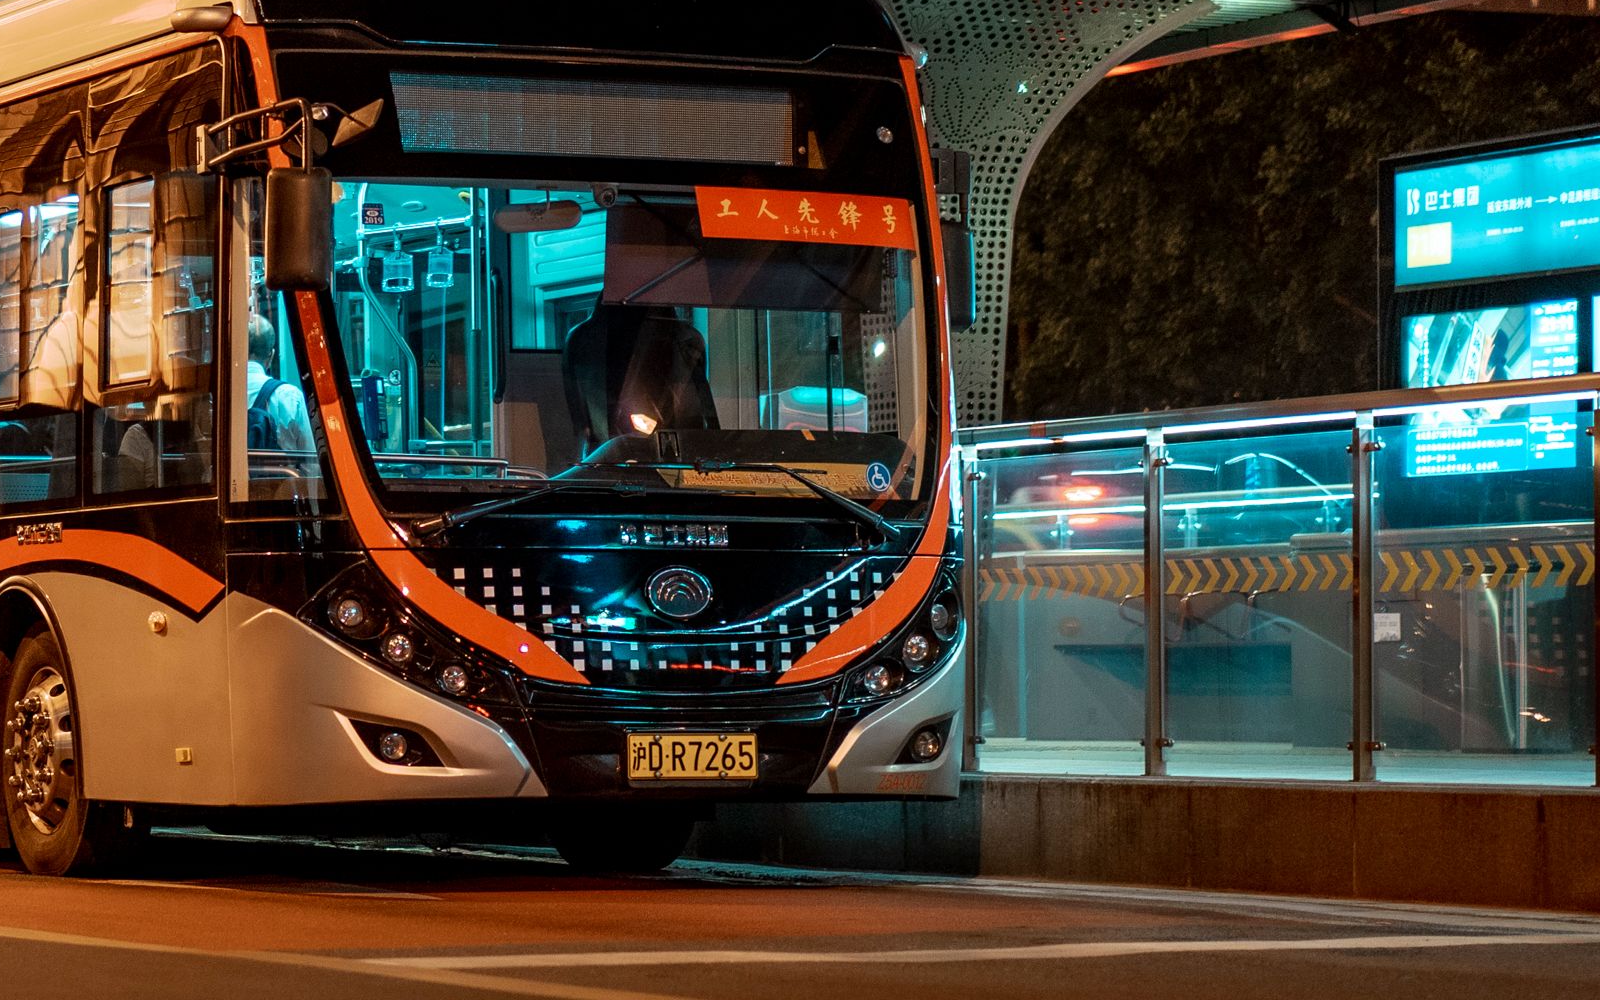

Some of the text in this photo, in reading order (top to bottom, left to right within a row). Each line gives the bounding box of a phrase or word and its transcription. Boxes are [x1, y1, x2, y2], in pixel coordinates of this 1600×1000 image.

[1425, 185, 1479, 212] 巴士集团
[364, 216, 383, 224] 2019
[717, 198, 897, 234] 工人先锋号
